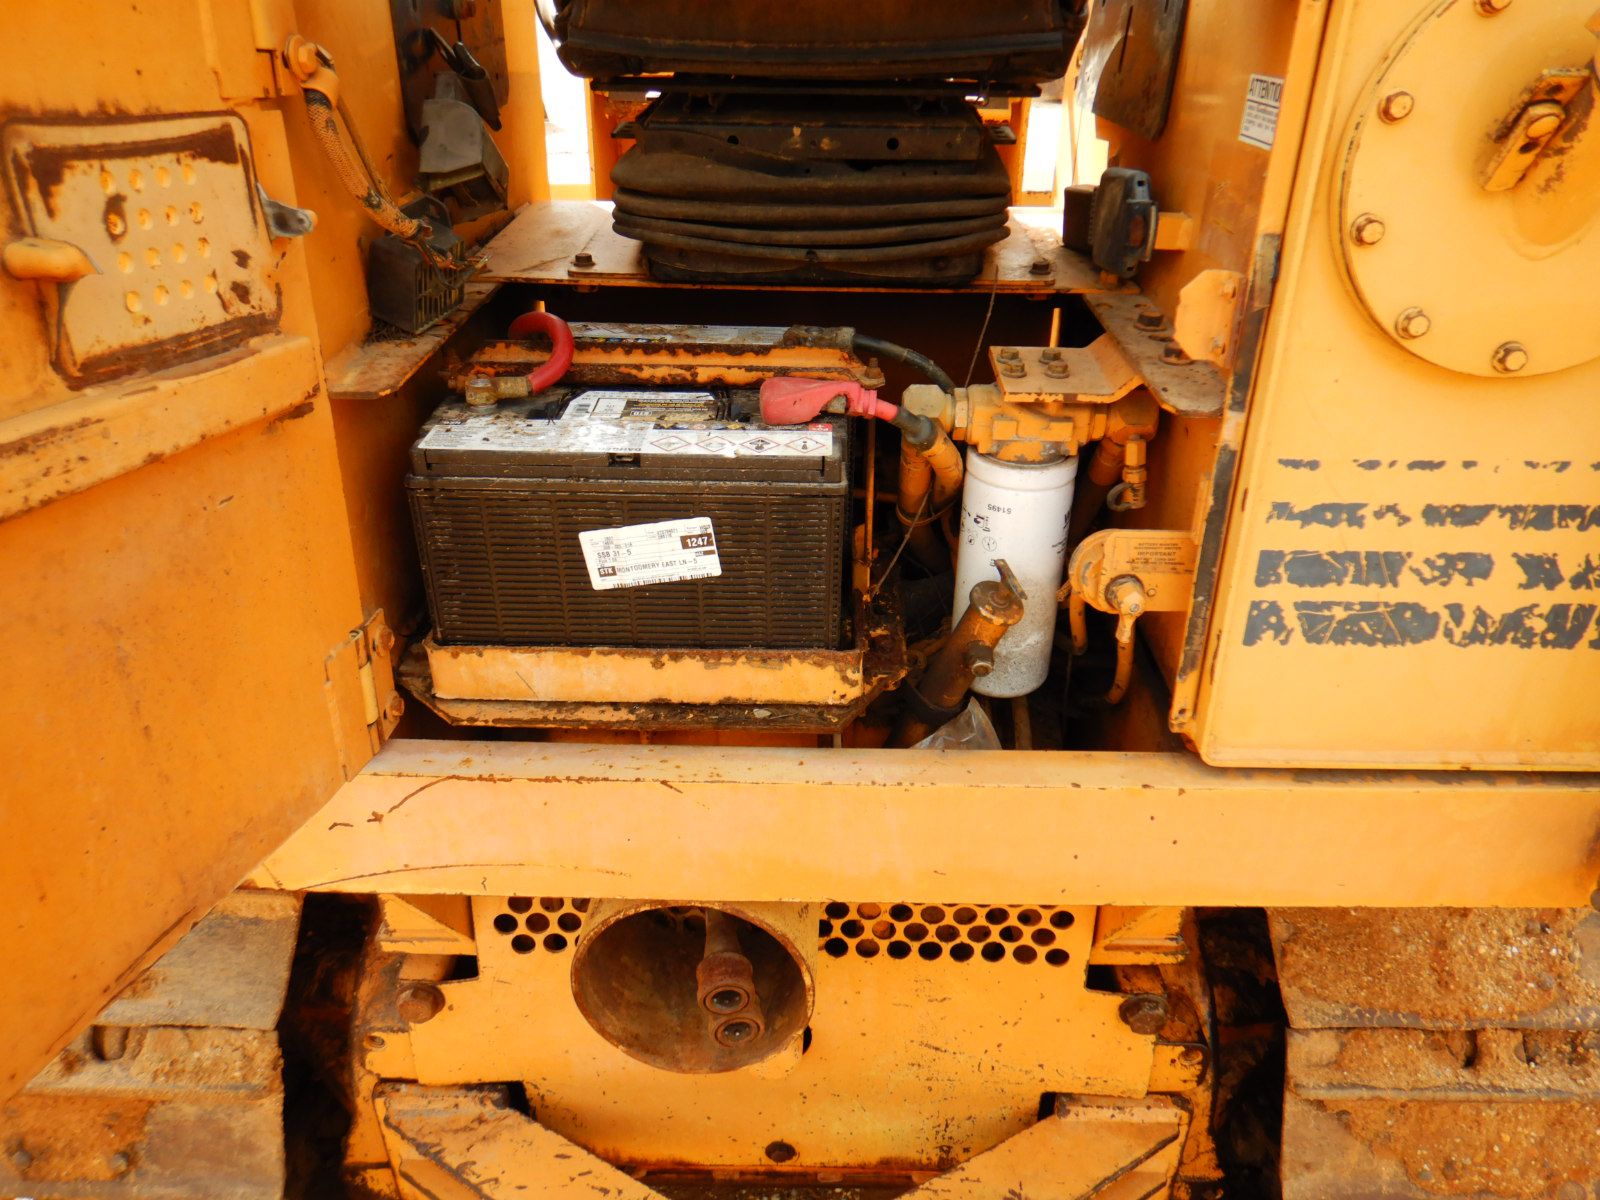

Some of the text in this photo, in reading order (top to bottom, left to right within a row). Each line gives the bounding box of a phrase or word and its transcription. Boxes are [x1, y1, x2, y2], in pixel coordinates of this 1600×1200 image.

[1250, 78, 1281, 102] ATTENTIO
[987, 504, 1012, 514] 51495
[686, 537, 708, 547] 1247
[600, 567, 614, 575] STK
[616, 563, 660, 574] MONTGOMERY
[662, 560, 677, 568] EAST
